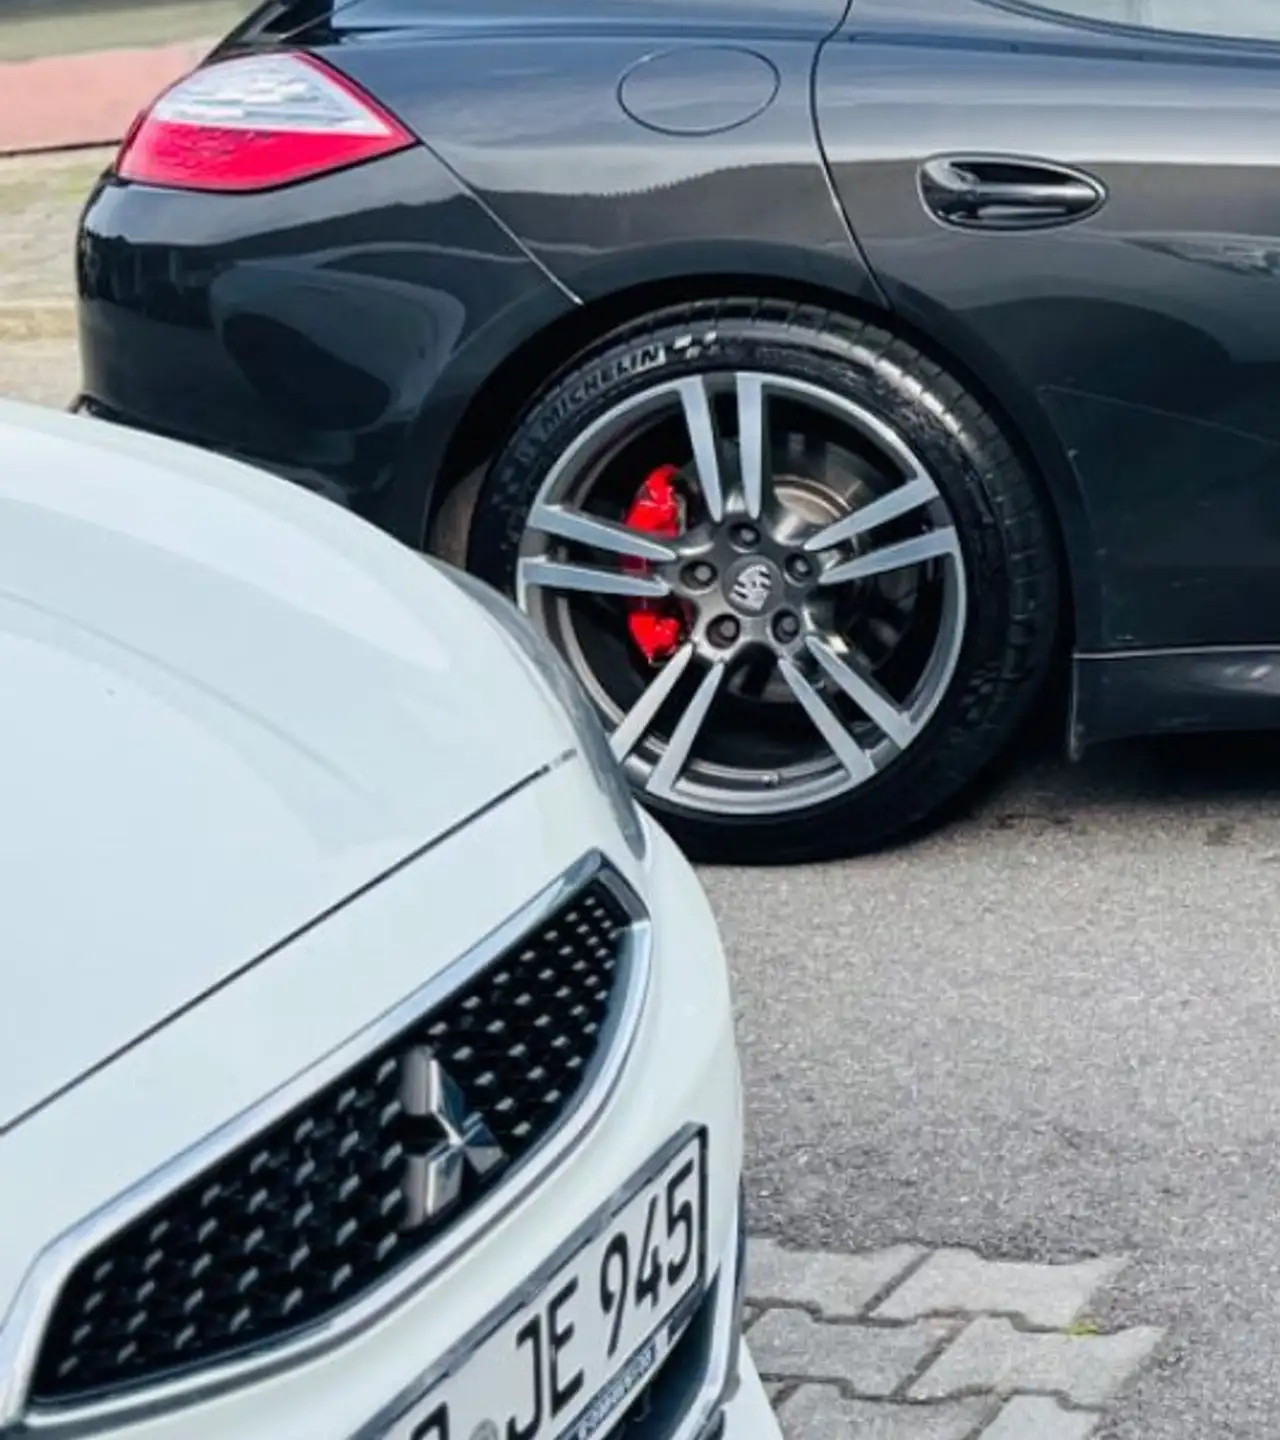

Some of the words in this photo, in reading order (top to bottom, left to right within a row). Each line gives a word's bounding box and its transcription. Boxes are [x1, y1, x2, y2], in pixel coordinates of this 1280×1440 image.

[541, 341, 665, 434] MICHELIN
[506, 1274, 585, 1440] JE
[600, 1157, 695, 1359] 945
